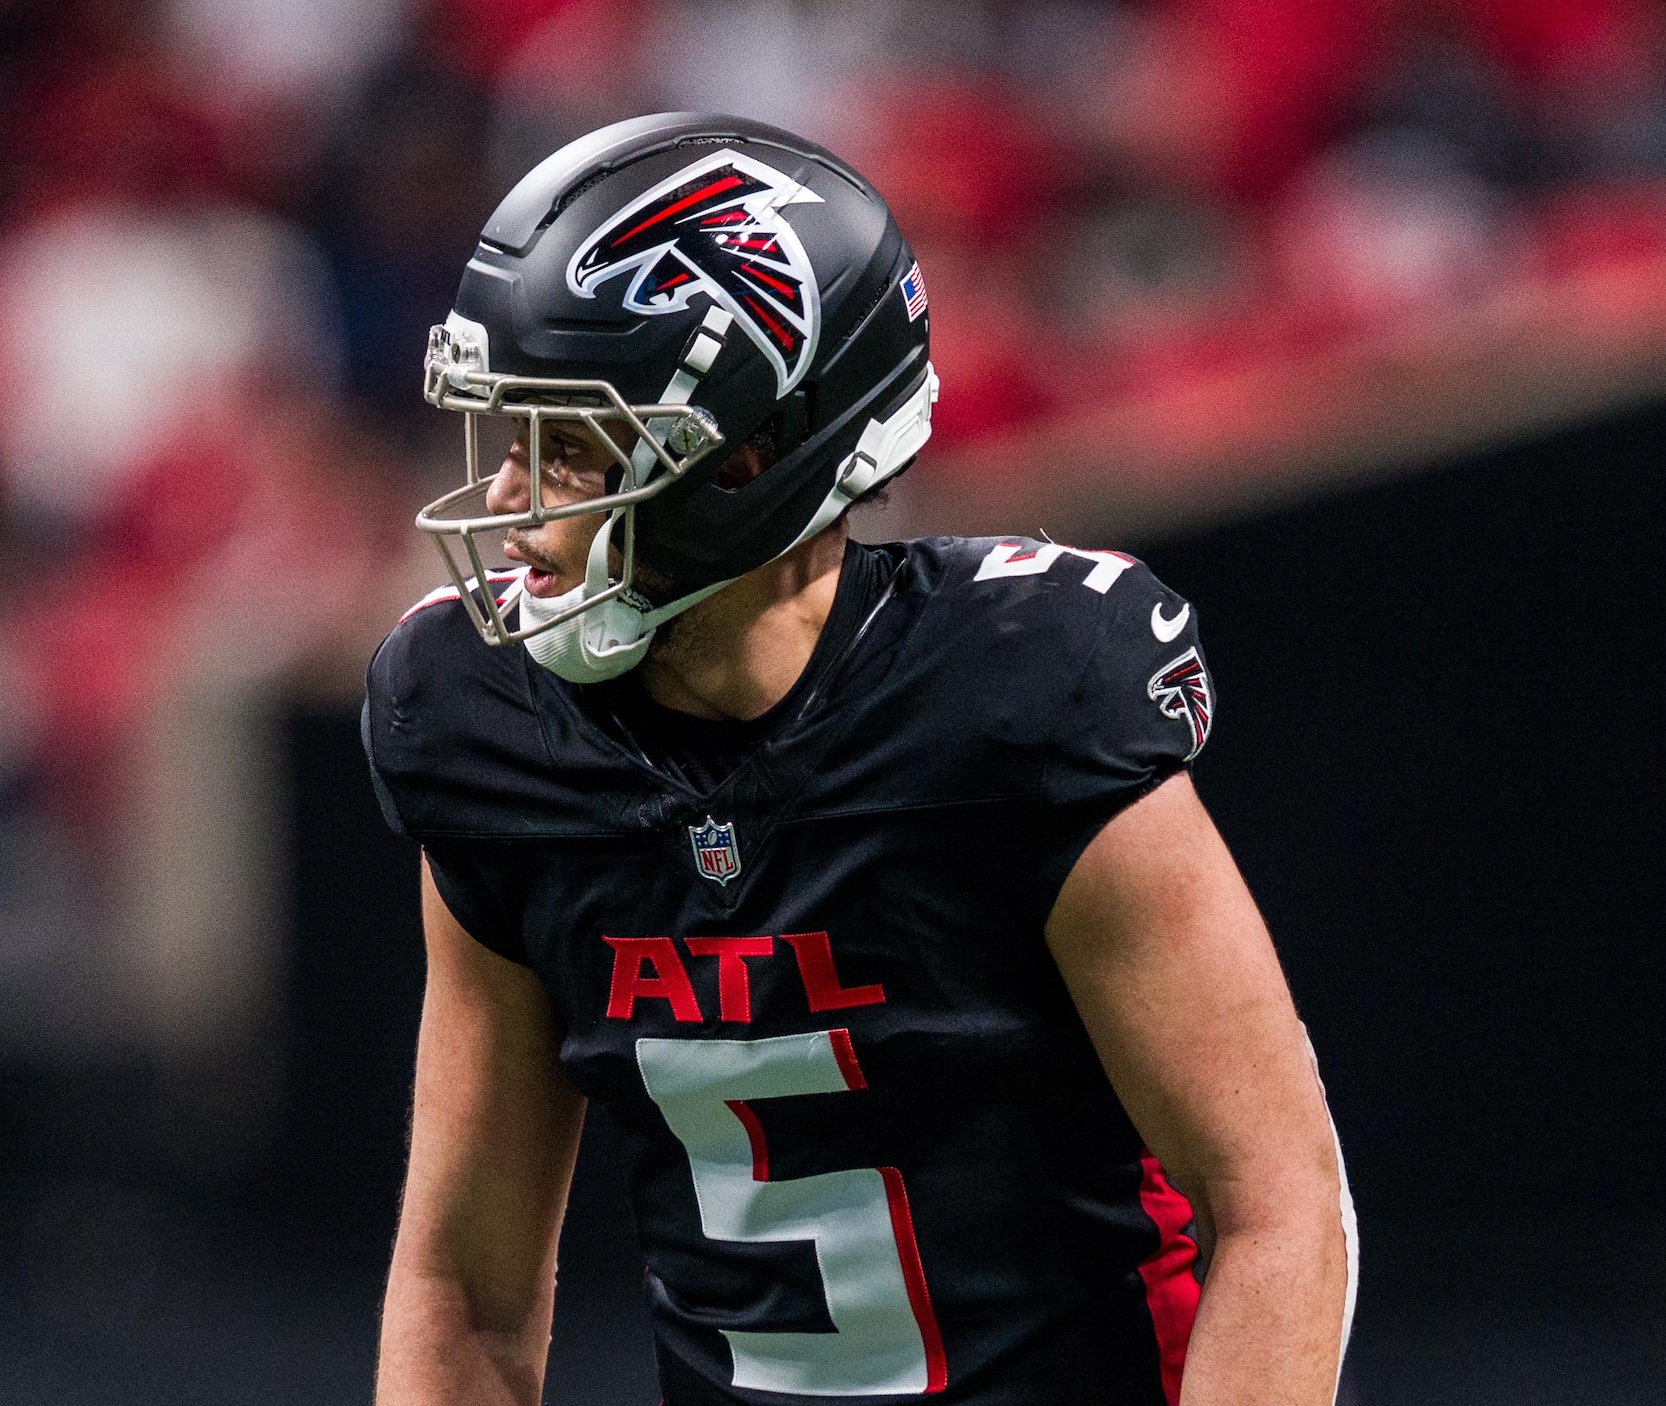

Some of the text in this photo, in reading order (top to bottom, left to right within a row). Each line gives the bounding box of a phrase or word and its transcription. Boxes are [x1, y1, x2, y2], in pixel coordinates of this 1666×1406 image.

[700, 849, 734, 874] NFL
[602, 931, 886, 1023] ATL
[635, 1028, 948, 1397] 5
